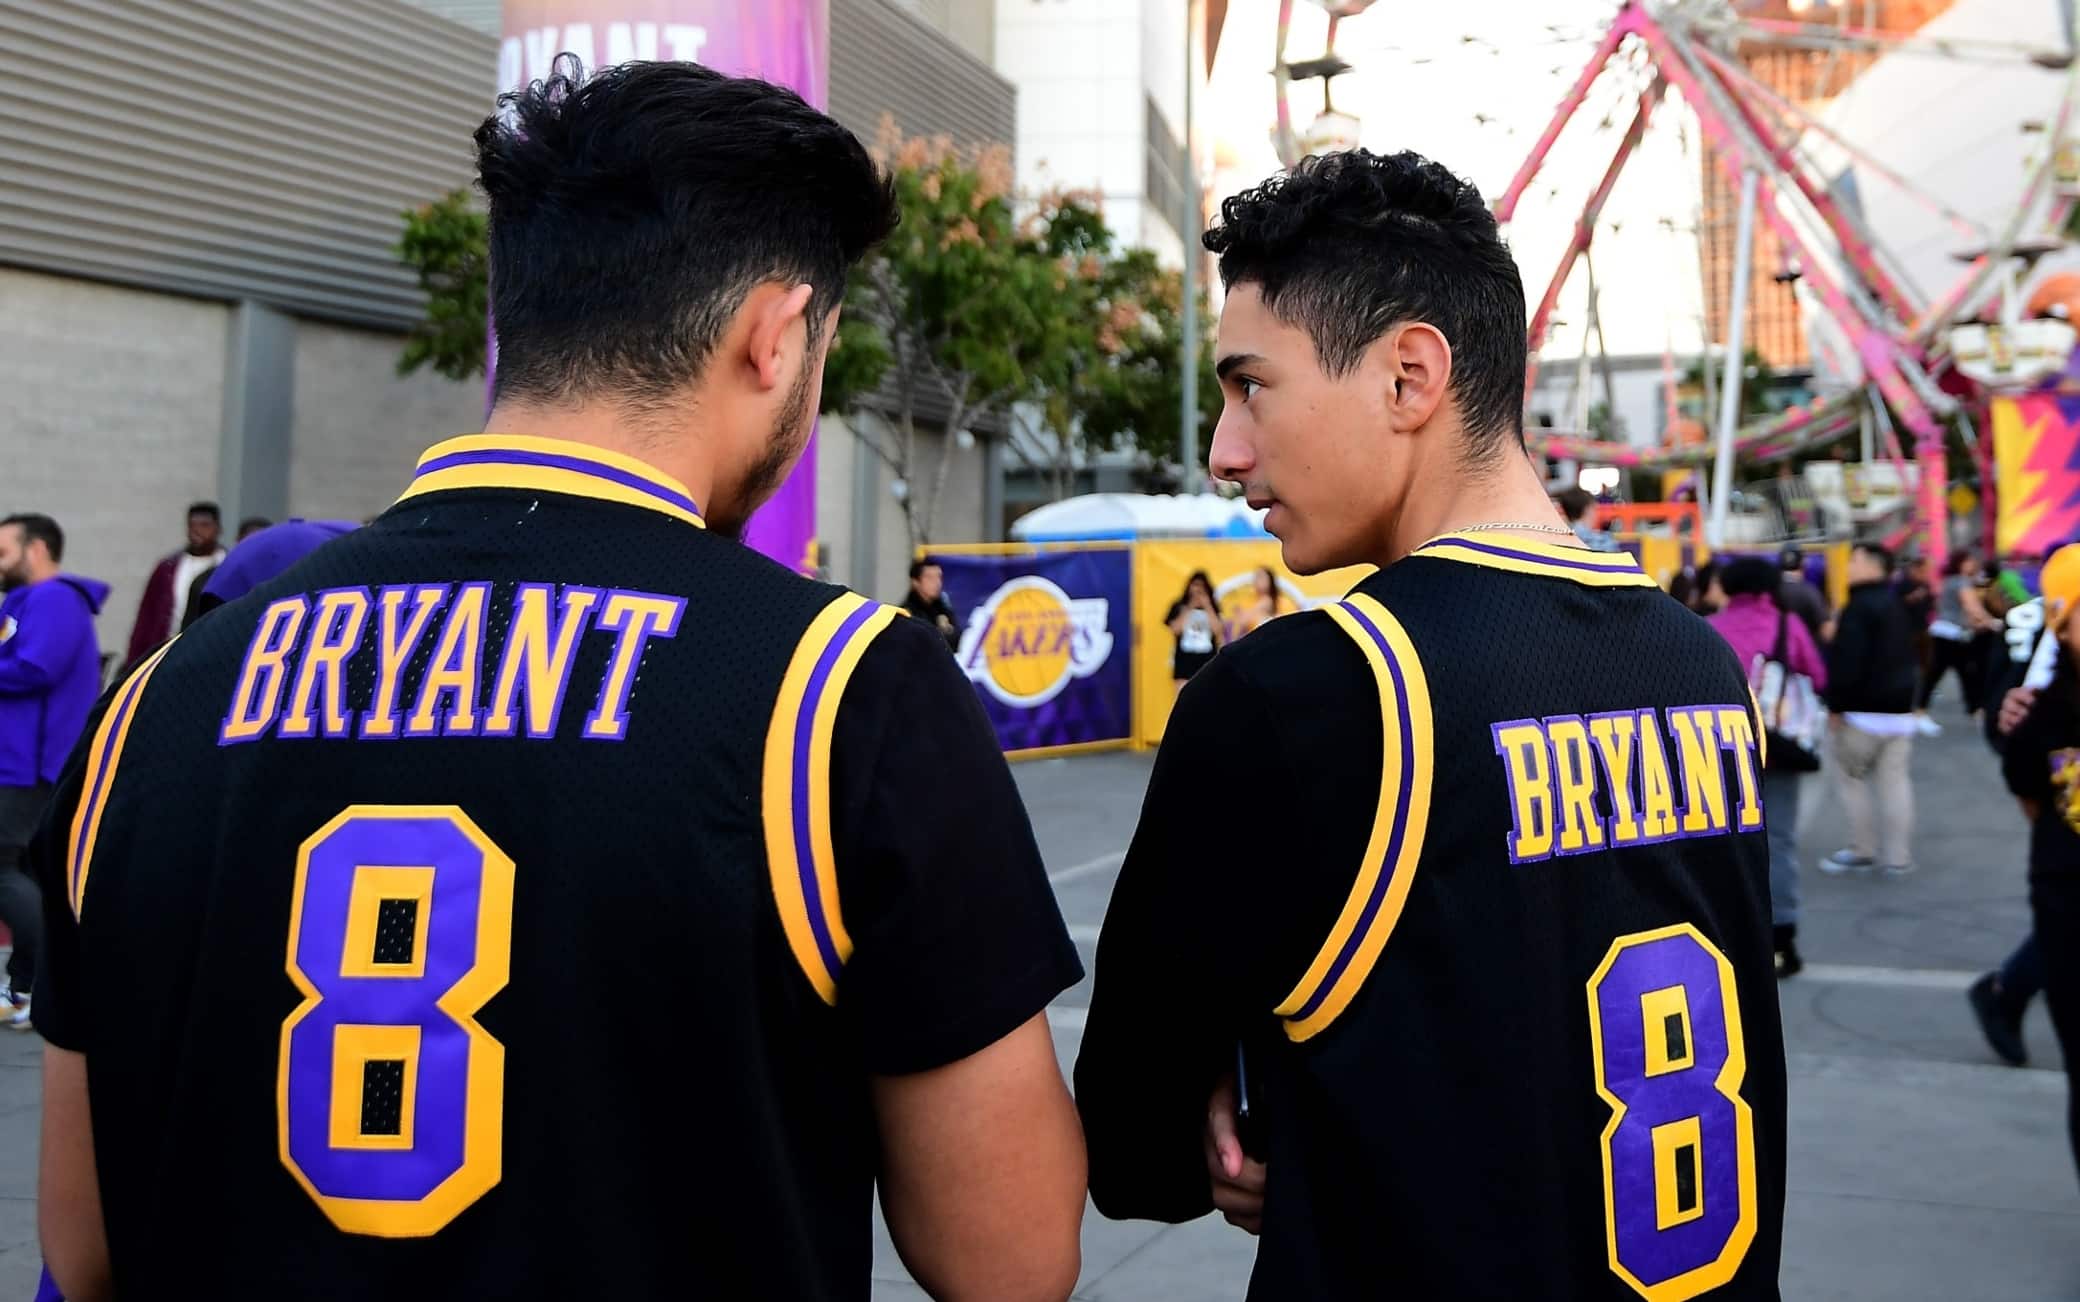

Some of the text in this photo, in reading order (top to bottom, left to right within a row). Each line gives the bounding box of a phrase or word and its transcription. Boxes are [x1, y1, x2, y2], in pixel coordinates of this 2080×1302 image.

[218, 581, 688, 745] BRYANT
[1490, 704, 1765, 864] BRYANT
[276, 805, 516, 1238] 8
[1586, 922, 1758, 1302] 8
